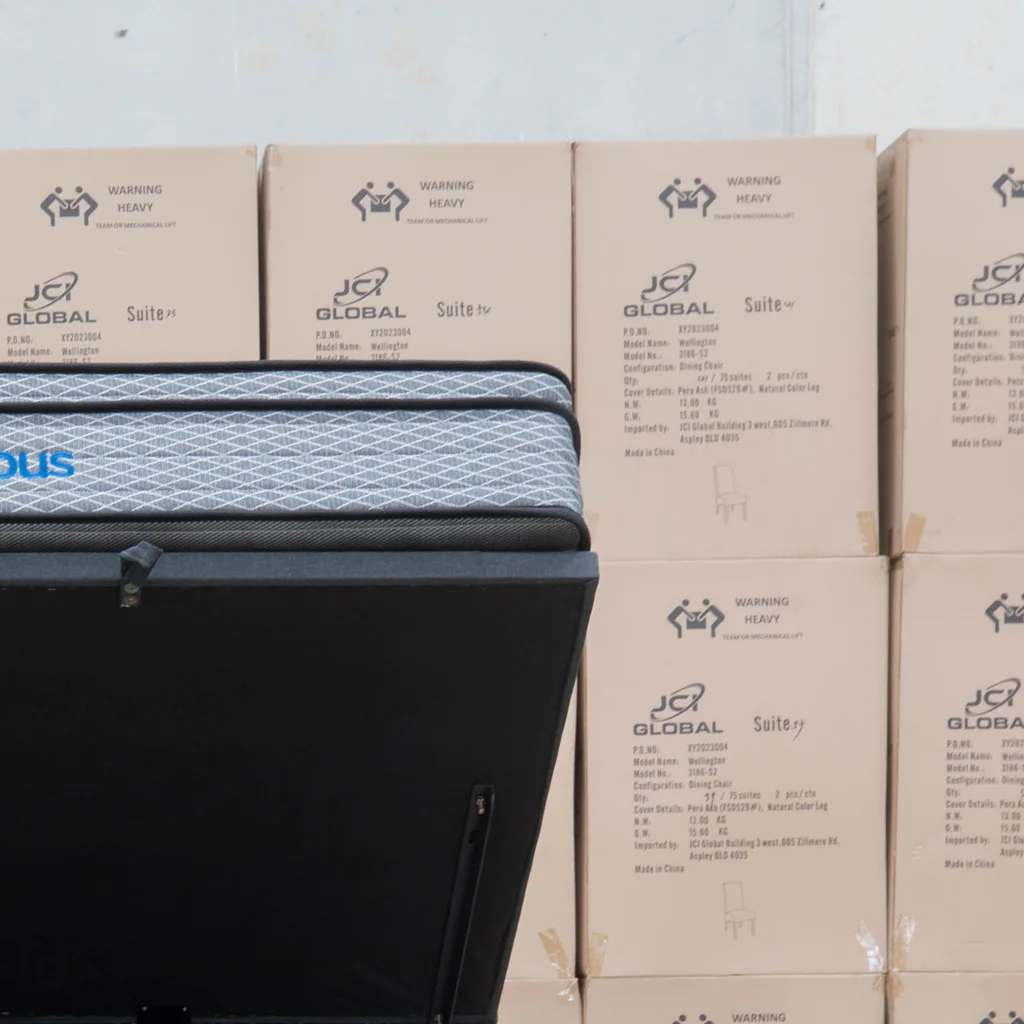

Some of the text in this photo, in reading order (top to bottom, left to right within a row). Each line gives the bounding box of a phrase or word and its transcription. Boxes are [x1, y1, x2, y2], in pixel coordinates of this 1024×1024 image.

[420, 181, 474, 191] WARNING
[728, 176, 782, 186] WARNING
[108, 185, 162, 195] WARNING
[429, 198, 464, 208] HEAVY
[737, 194, 772, 204] HEAVY
[118, 203, 152, 213] HEAVY
[973, 265, 1021, 283] JCI
[24, 283, 71, 302] JCI
[334, 278, 381, 297] JCI
[437, 301, 474, 317] Suite
[624, 302, 714, 317] GLOBAL
[745, 297, 782, 313] Suite
[7, 311, 96, 325] GLOBAL
[127, 305, 163, 321] Suite
[316, 306, 406, 320] GLOBAL
[736, 597, 790, 607] WARNING
[745, 614, 780, 625] HEAVY
[650, 694, 698, 713] JCI
[966, 690, 1014, 707] JCI
[634, 722, 722, 735] GLOBAL
[754, 716, 790, 732] Suite
[732, 1013, 785, 1023] WARNING
